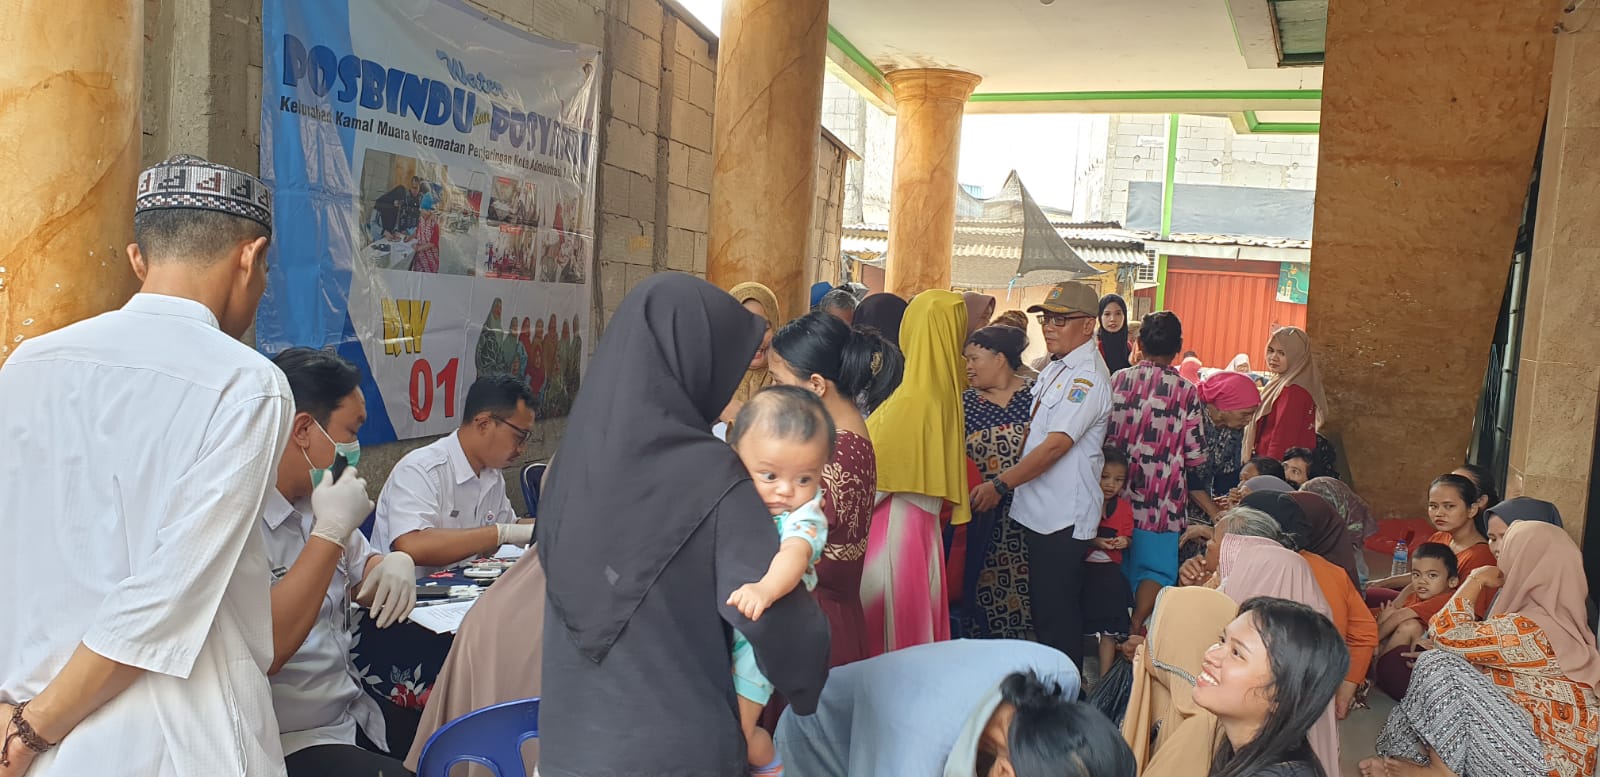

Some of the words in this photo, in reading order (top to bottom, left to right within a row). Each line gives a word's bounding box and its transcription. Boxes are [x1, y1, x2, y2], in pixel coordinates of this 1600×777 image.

[282, 34, 476, 134] POSBINDU
[280, 95, 332, 124] Kelurahan
[335, 110, 374, 133] Kamal
[377, 121, 410, 141] Muara
[412, 129, 466, 155] Kecamatan
[409, 358, 459, 422] 01
